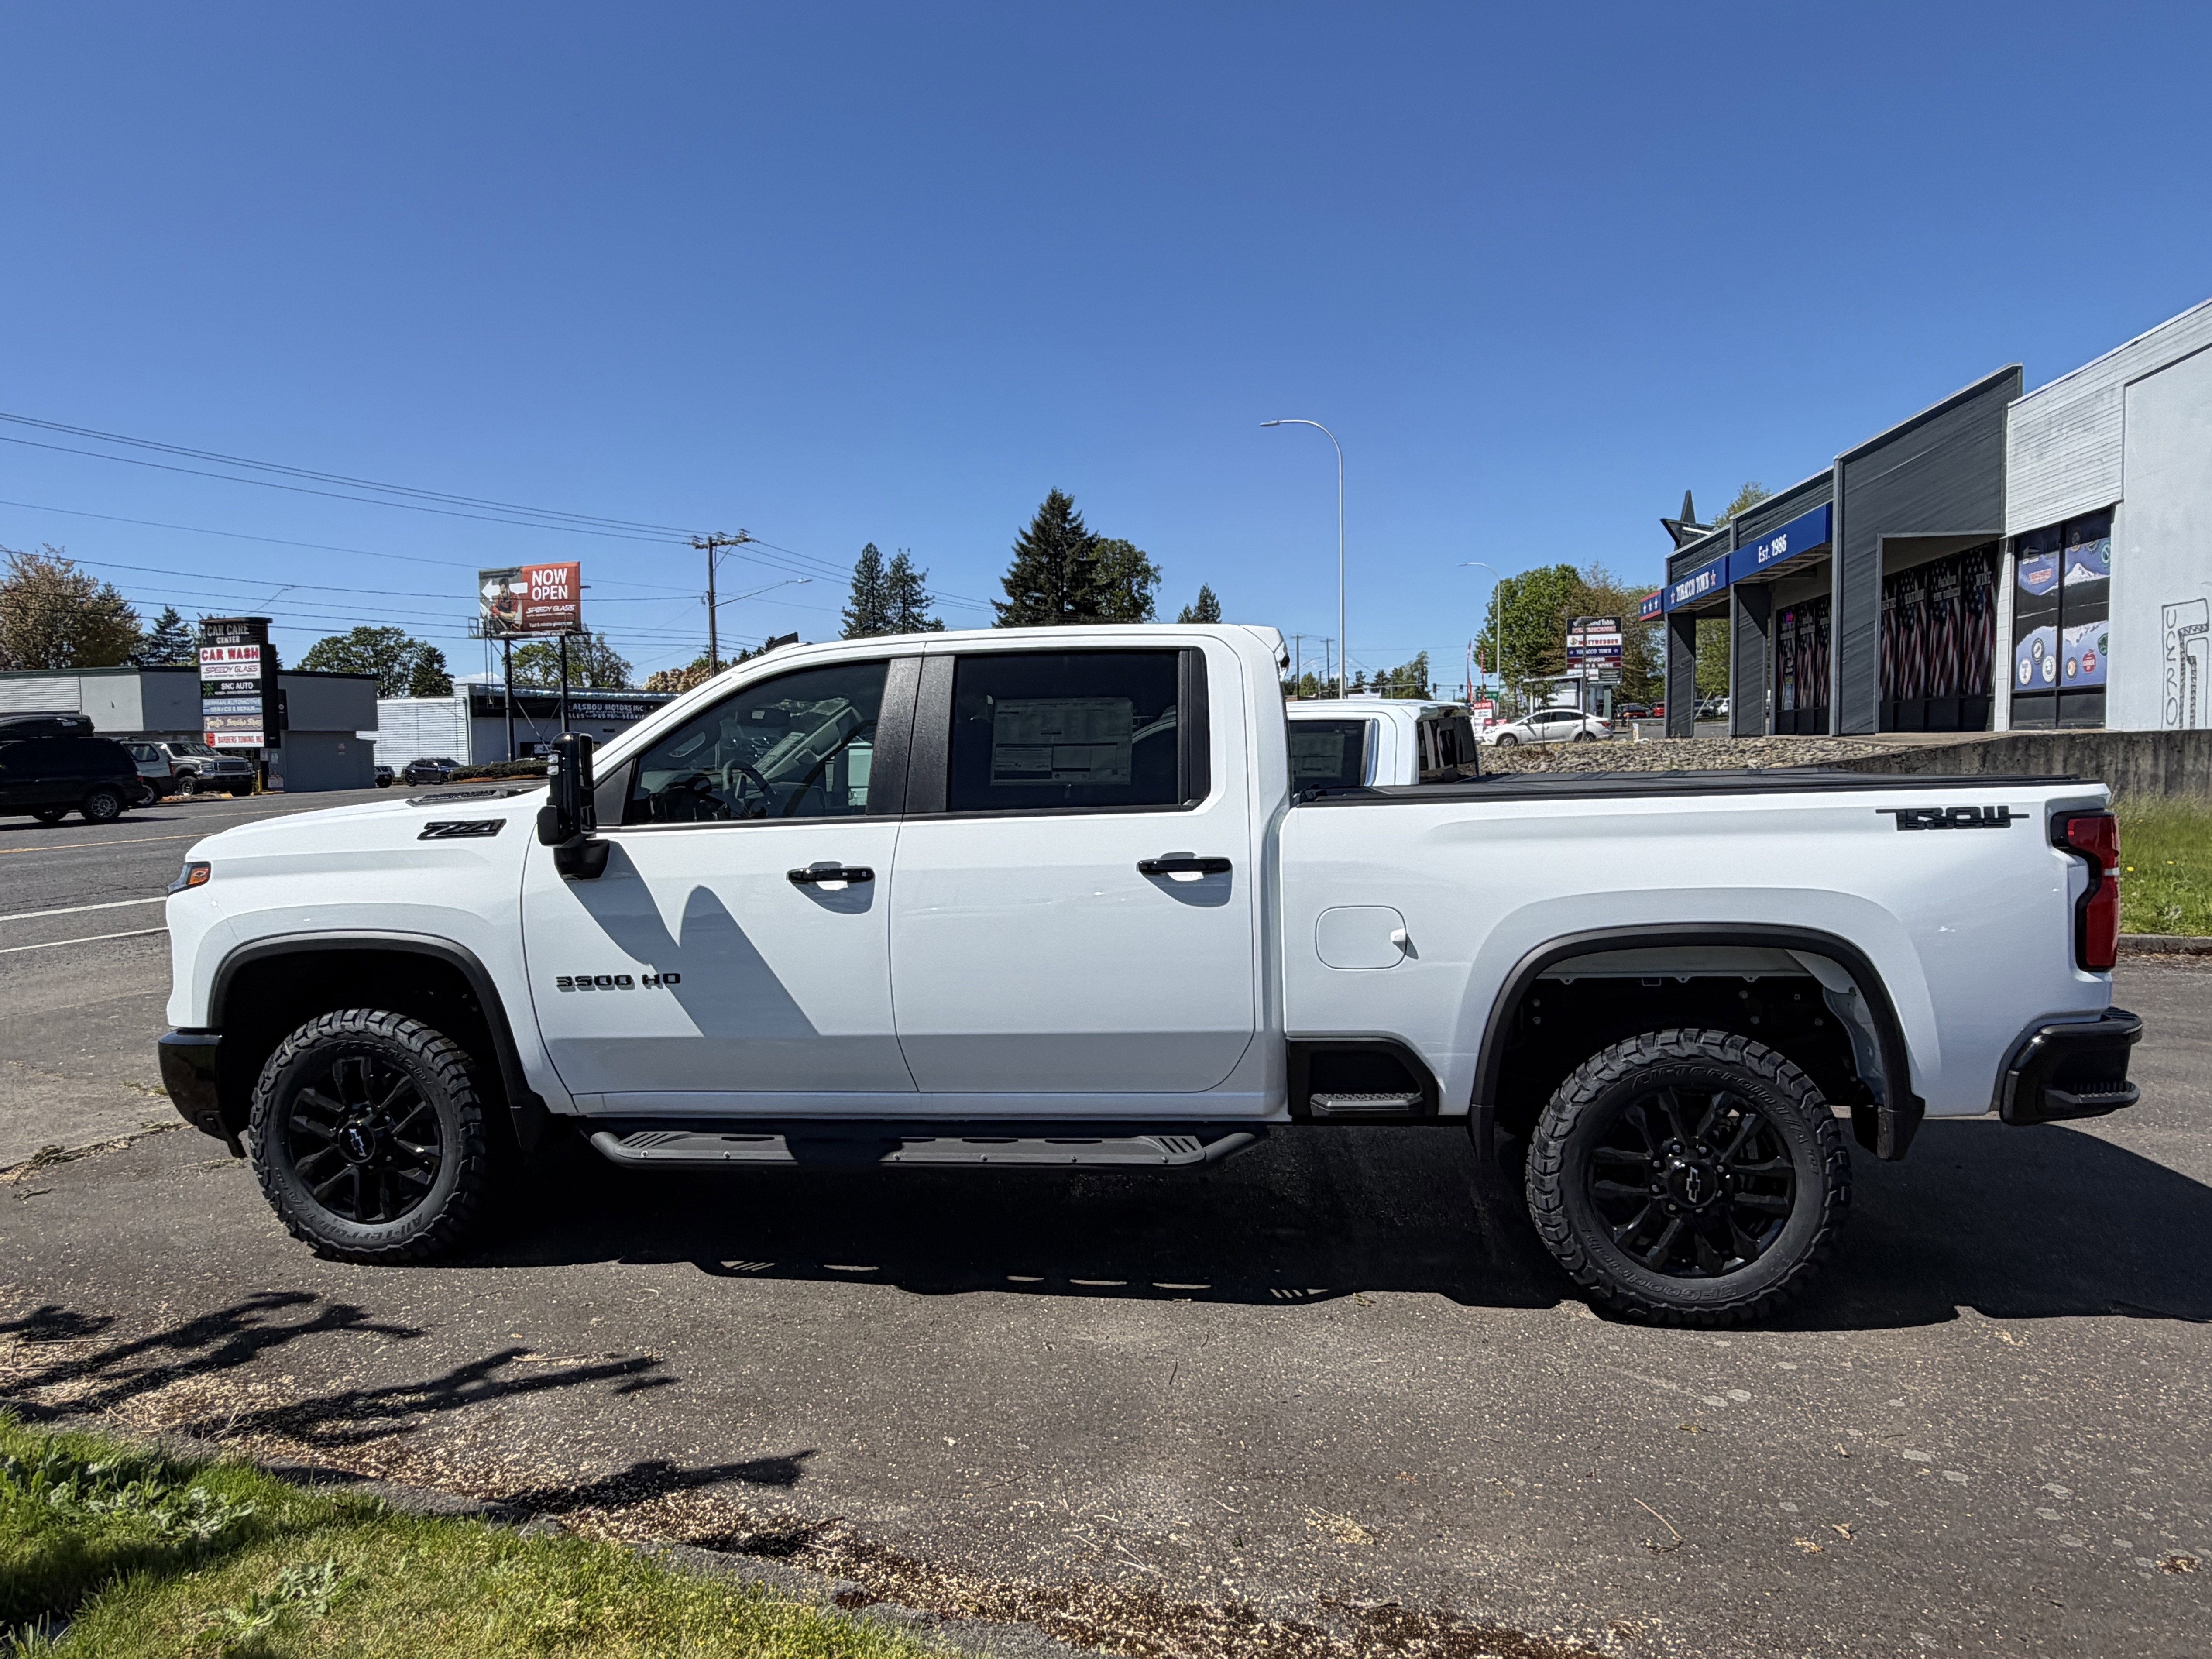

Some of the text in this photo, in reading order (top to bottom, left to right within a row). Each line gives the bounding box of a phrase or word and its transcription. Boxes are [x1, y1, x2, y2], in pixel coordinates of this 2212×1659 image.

[1758, 534, 1787, 563] Est. 1986
[532, 568, 568, 586] NOW
[531, 584, 568, 601] OPEN
[1676, 571, 1709, 602] TOBACCO TOWN
[525, 606, 552, 614] SPEEDY
[207, 623, 250, 637] CAR CARE
[216, 635, 240, 644] CENTER
[201, 647, 259, 661] CAR WASH
[203, 665, 258, 674] SPEEDY GLASS
[417, 818, 507, 840] Z71
[1896, 818, 2011, 831] BOSS
[555, 973, 681, 987] 3500 HD
[1632, 1063, 1777, 1104] All-Terrain
